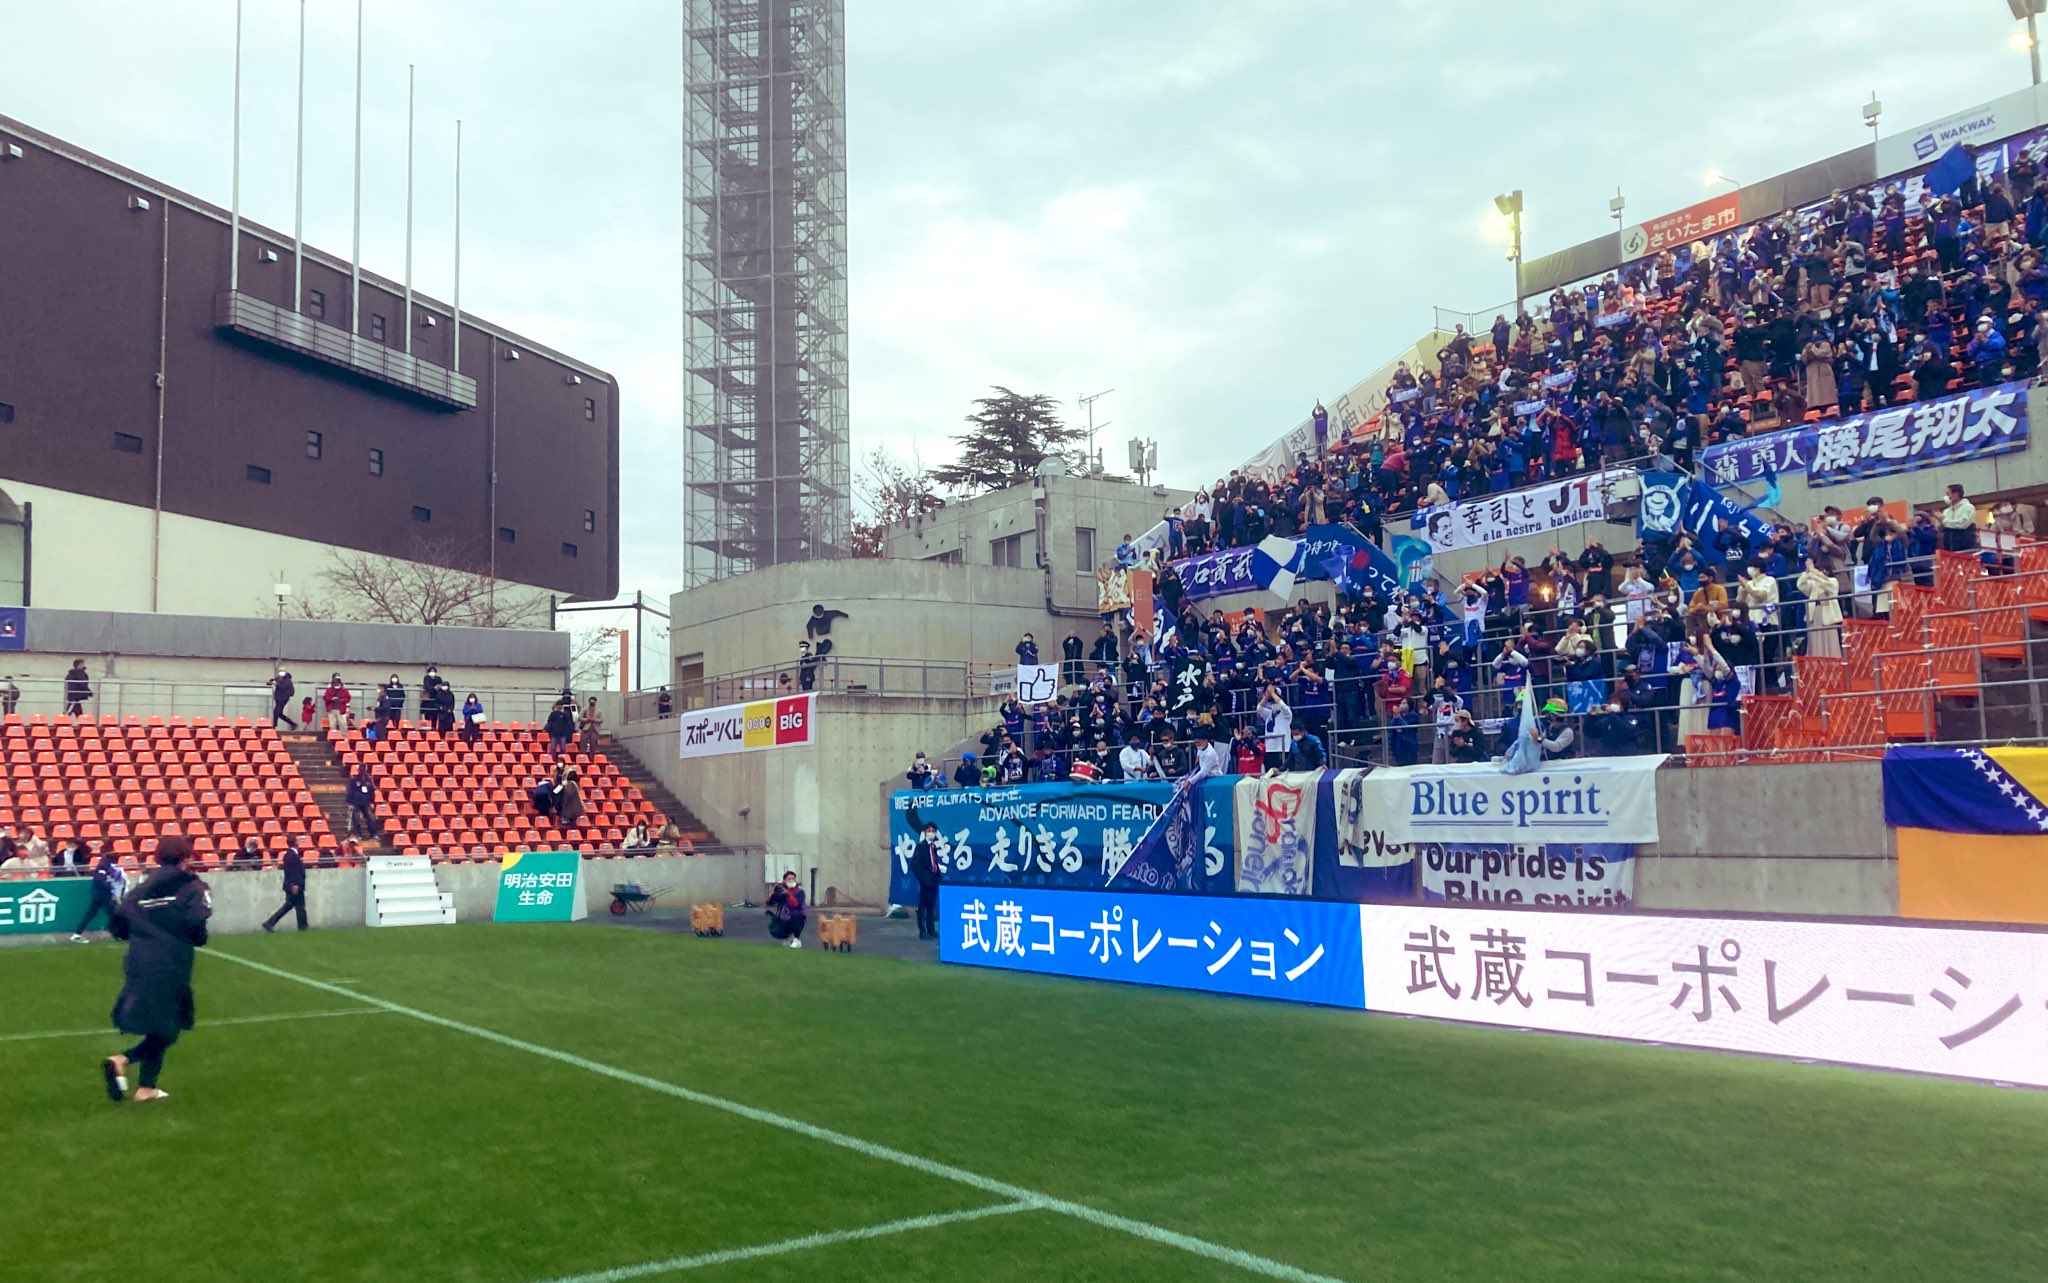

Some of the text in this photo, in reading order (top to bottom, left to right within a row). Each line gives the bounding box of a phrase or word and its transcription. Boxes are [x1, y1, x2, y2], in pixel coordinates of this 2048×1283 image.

[1939, 115, 1996, 141] WAKWAK
[1649, 207, 1736, 248] さいたま市
[1812, 390, 2018, 473] 藤尾翔太
[1462, 475, 1592, 534] 幸司と J1
[1506, 522, 1542, 537] nostra
[1550, 507, 1602, 528] bandiera
[1172, 663, 1202, 711] 水戸
[686, 717, 743, 746] スポーツくじ
[894, 796, 910, 810] WE
[911, 795, 934, 809] ARE
[936, 792, 983, 806] ALWAYS
[978, 801, 1218, 822] ADVANCE FORWARD FEARLY.
[1410, 779, 1489, 816] Blue
[1501, 775, 1610, 827] spirit.
[988, 823, 1083, 873] 走りきる
[1101, 826, 1225, 879] 勝る
[1426, 842, 1606, 882] Our pride is
[504, 872, 574, 888] 明治安田
[517, 889, 554, 906] 生命
[1444, 880, 1523, 904] Blue
[960, 898, 1325, 982] 武蔵コーポレーション
[1403, 925, 2048, 1049] 武蔵コーポレーシ
